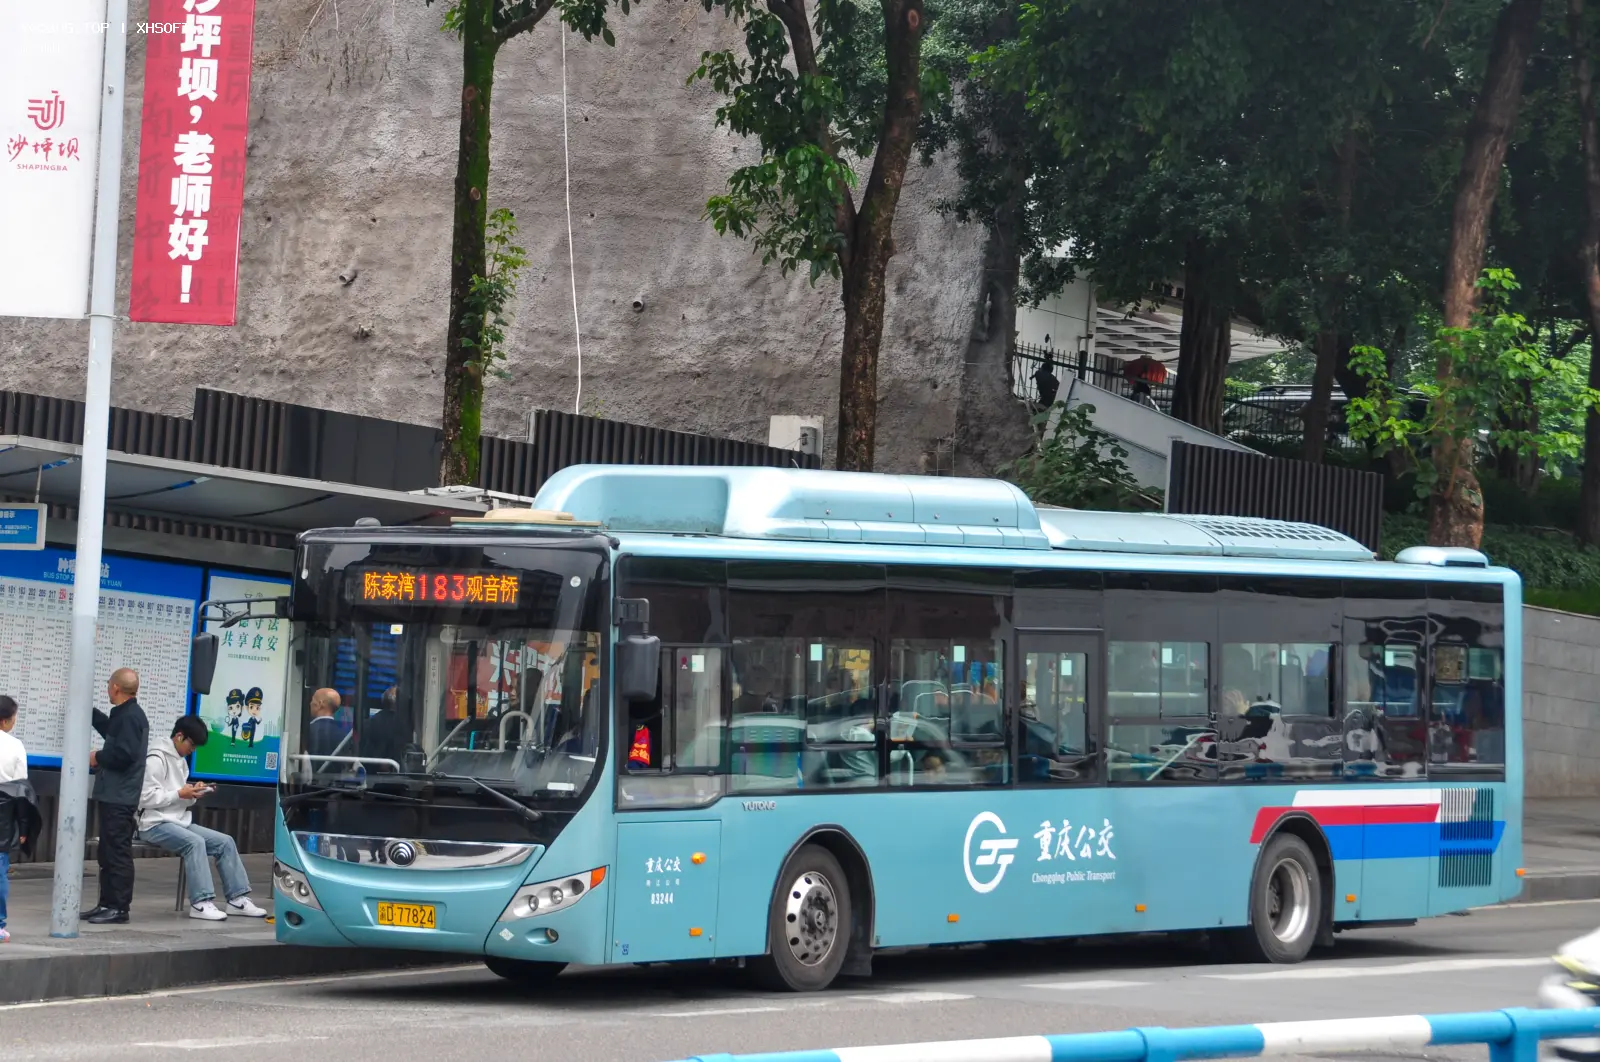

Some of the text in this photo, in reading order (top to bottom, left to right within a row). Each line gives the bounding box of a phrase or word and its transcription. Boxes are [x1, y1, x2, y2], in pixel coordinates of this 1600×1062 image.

[7, 134, 80, 162] 沙坪坝
[16, 163, 68, 171] SHAPINGBA
[221, 630, 279, 651] 共享食安
[741, 801, 776, 811] YUTONG
[1033, 818, 1117, 862] 重庆公交
[645, 856, 682, 874] 重庆公交
[1032, 870, 1116, 885] Chongqing Public Transport
